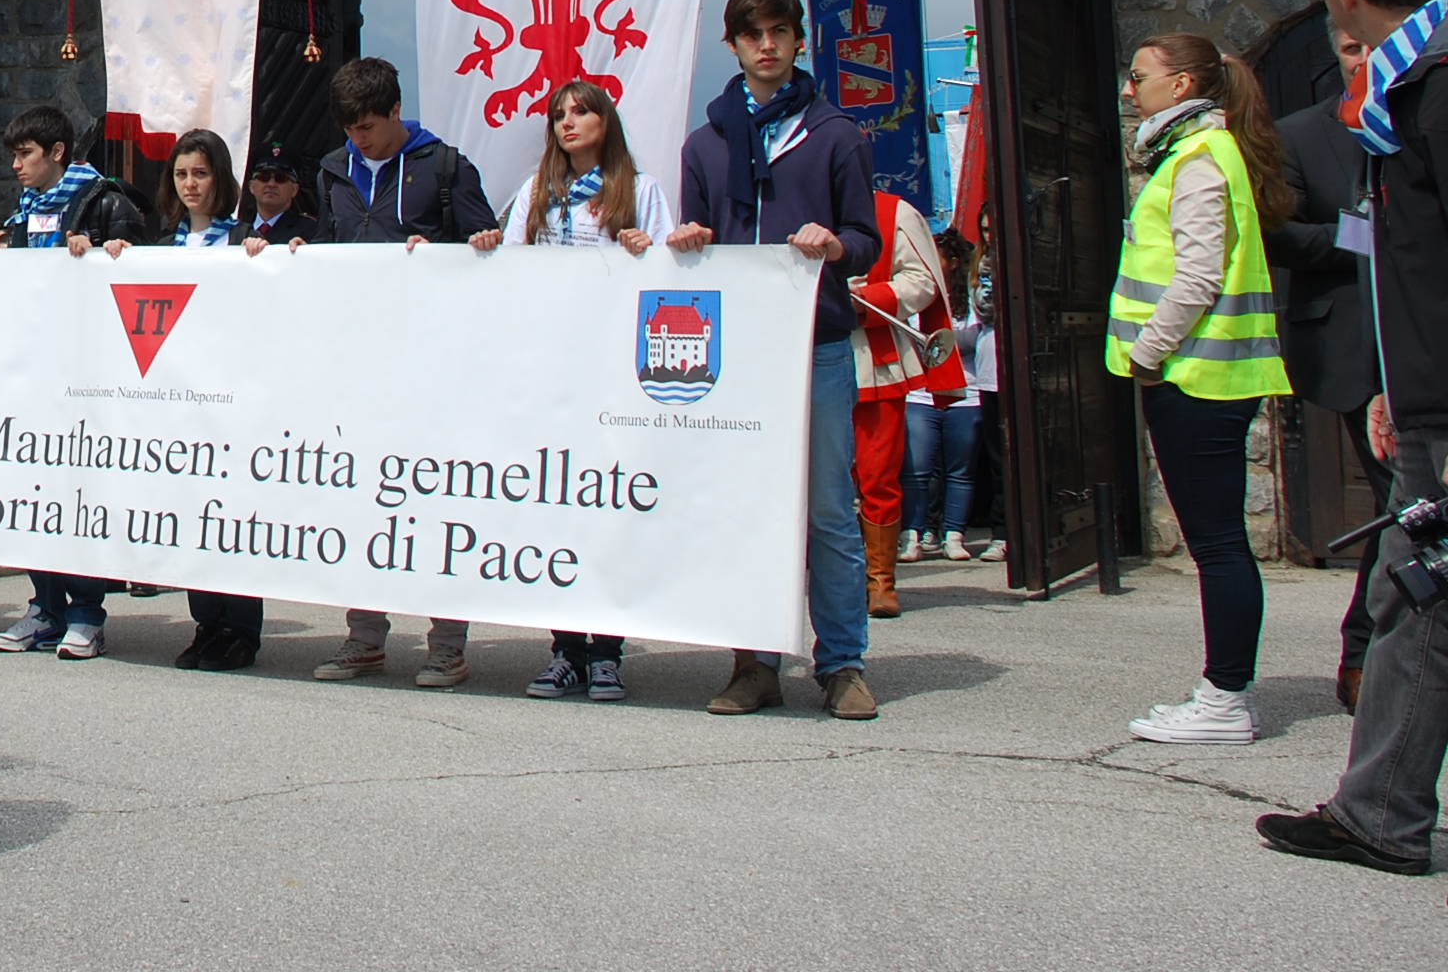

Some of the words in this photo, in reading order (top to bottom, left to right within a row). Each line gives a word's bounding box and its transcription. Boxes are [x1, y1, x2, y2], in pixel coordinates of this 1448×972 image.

[132, 299, 173, 335] IT
[64, 384, 115, 398] Associazione
[117, 386, 166, 402] Nazionale
[169, 388, 182, 402] Ex
[185, 389, 234, 406] Deportati
[598, 411, 649, 428] Comune
[653, 413, 668, 429] di
[672, 414, 762, 432] Mauthausen
[249, 425, 358, 489] città
[375, 446, 659, 512] gemellate
[73, 487, 112, 540] ha
[125, 506, 181, 548] un
[195, 498, 347, 565] futuro
[366, 515, 417, 572] di
[437, 520, 580, 588] Pace
